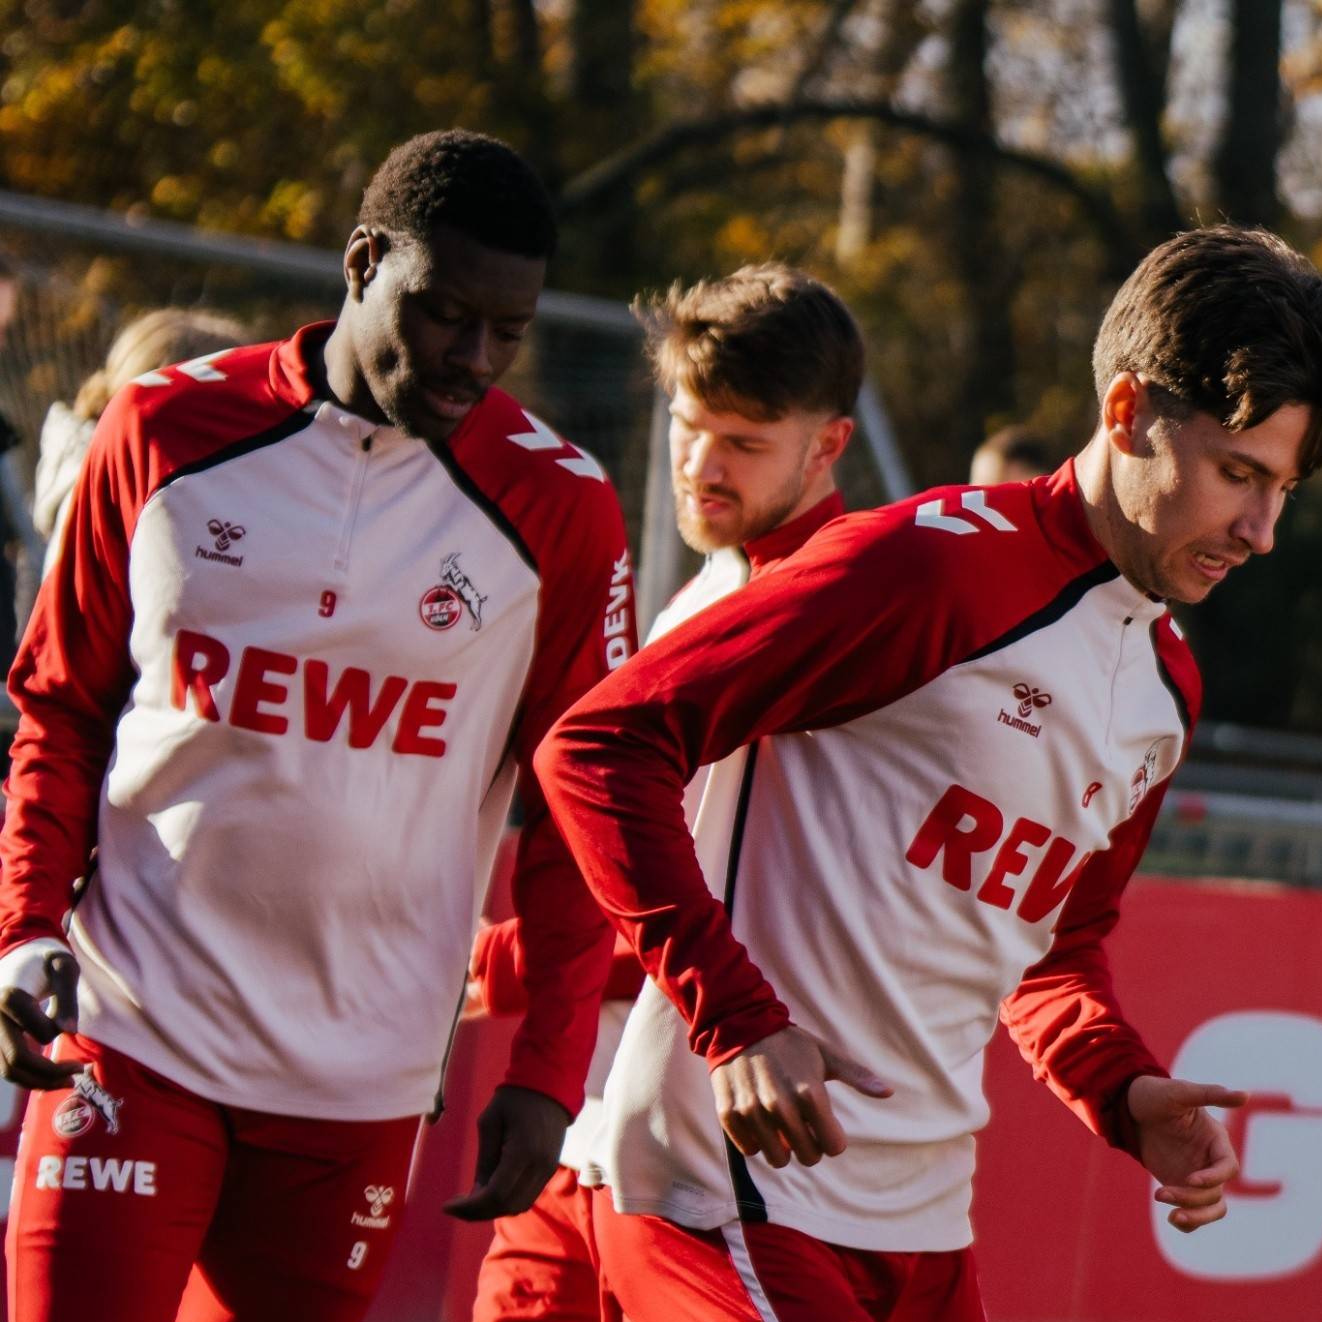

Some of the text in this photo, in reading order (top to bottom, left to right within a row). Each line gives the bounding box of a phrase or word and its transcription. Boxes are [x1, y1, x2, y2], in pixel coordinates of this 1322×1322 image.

[195, 546, 244, 567] hummel
[318, 590, 337, 618] 9
[603, 548, 630, 670] DEVK
[171, 629, 457, 757] REWE
[997, 708, 1042, 738] hummel
[36, 1156, 156, 1195] REWE
[346, 1241, 367, 1270] 9
